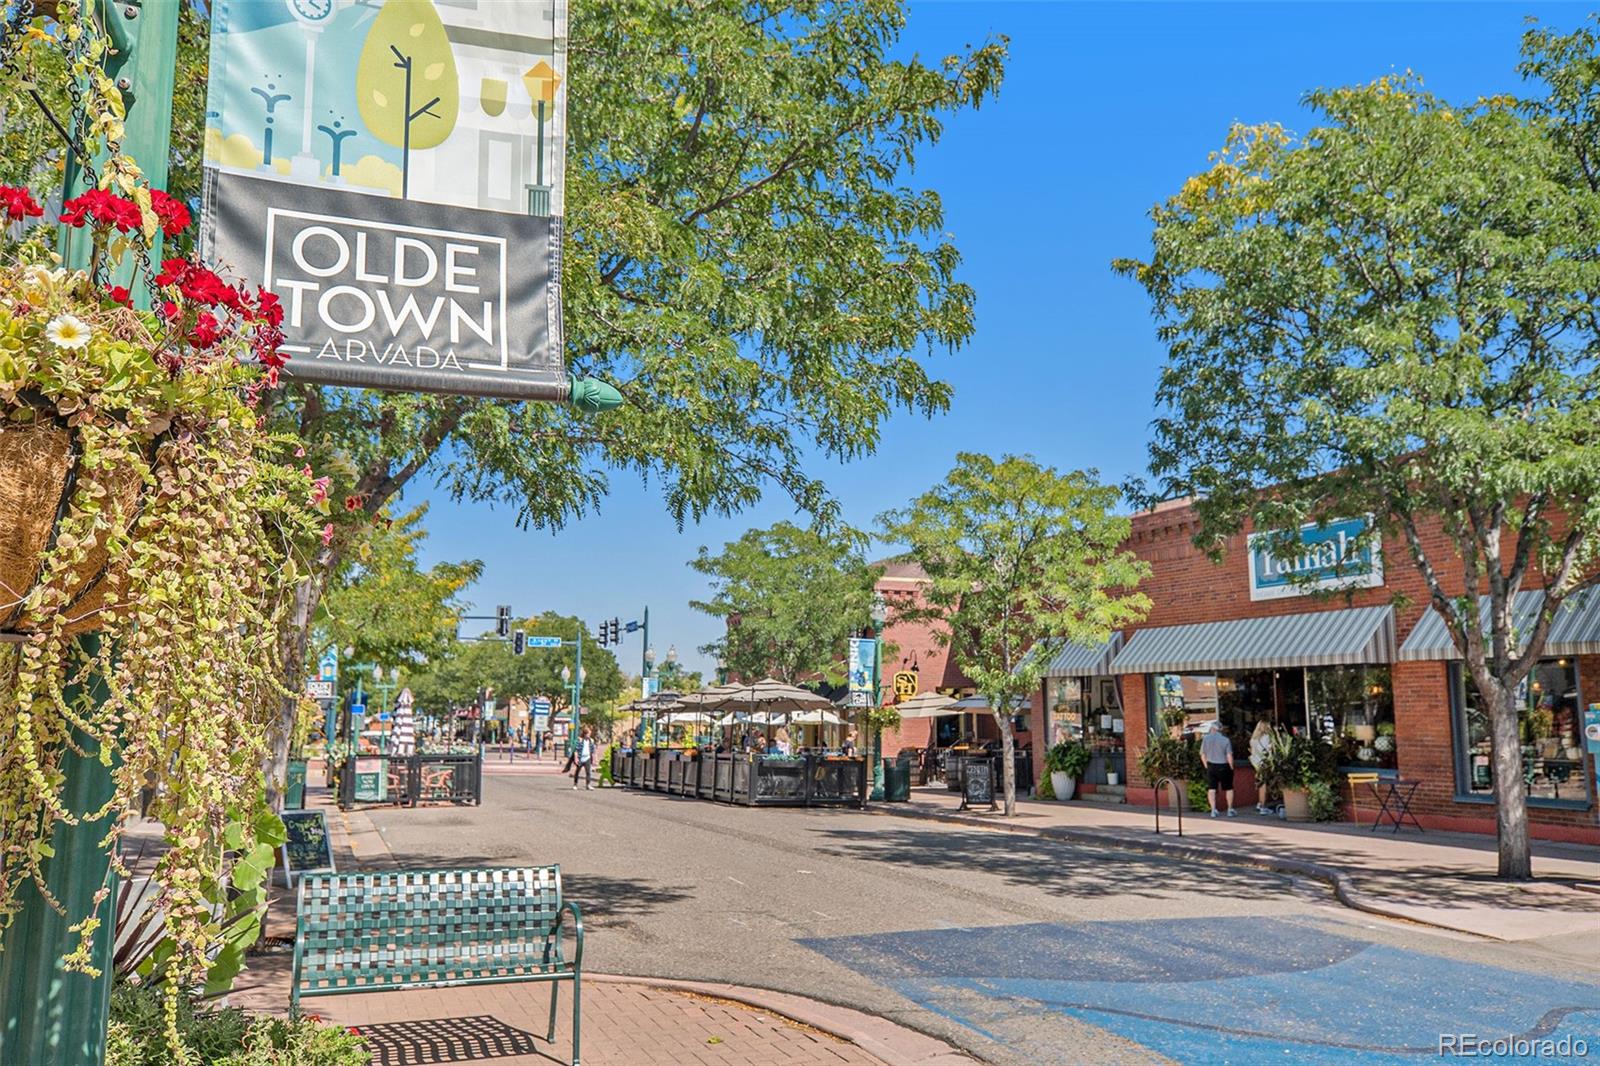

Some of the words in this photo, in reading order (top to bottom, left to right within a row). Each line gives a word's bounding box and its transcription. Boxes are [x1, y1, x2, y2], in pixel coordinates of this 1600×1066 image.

[292, 226, 480, 295] OLDE
[276, 279, 493, 346] TOWN
[316, 337, 464, 371] ARVADA
